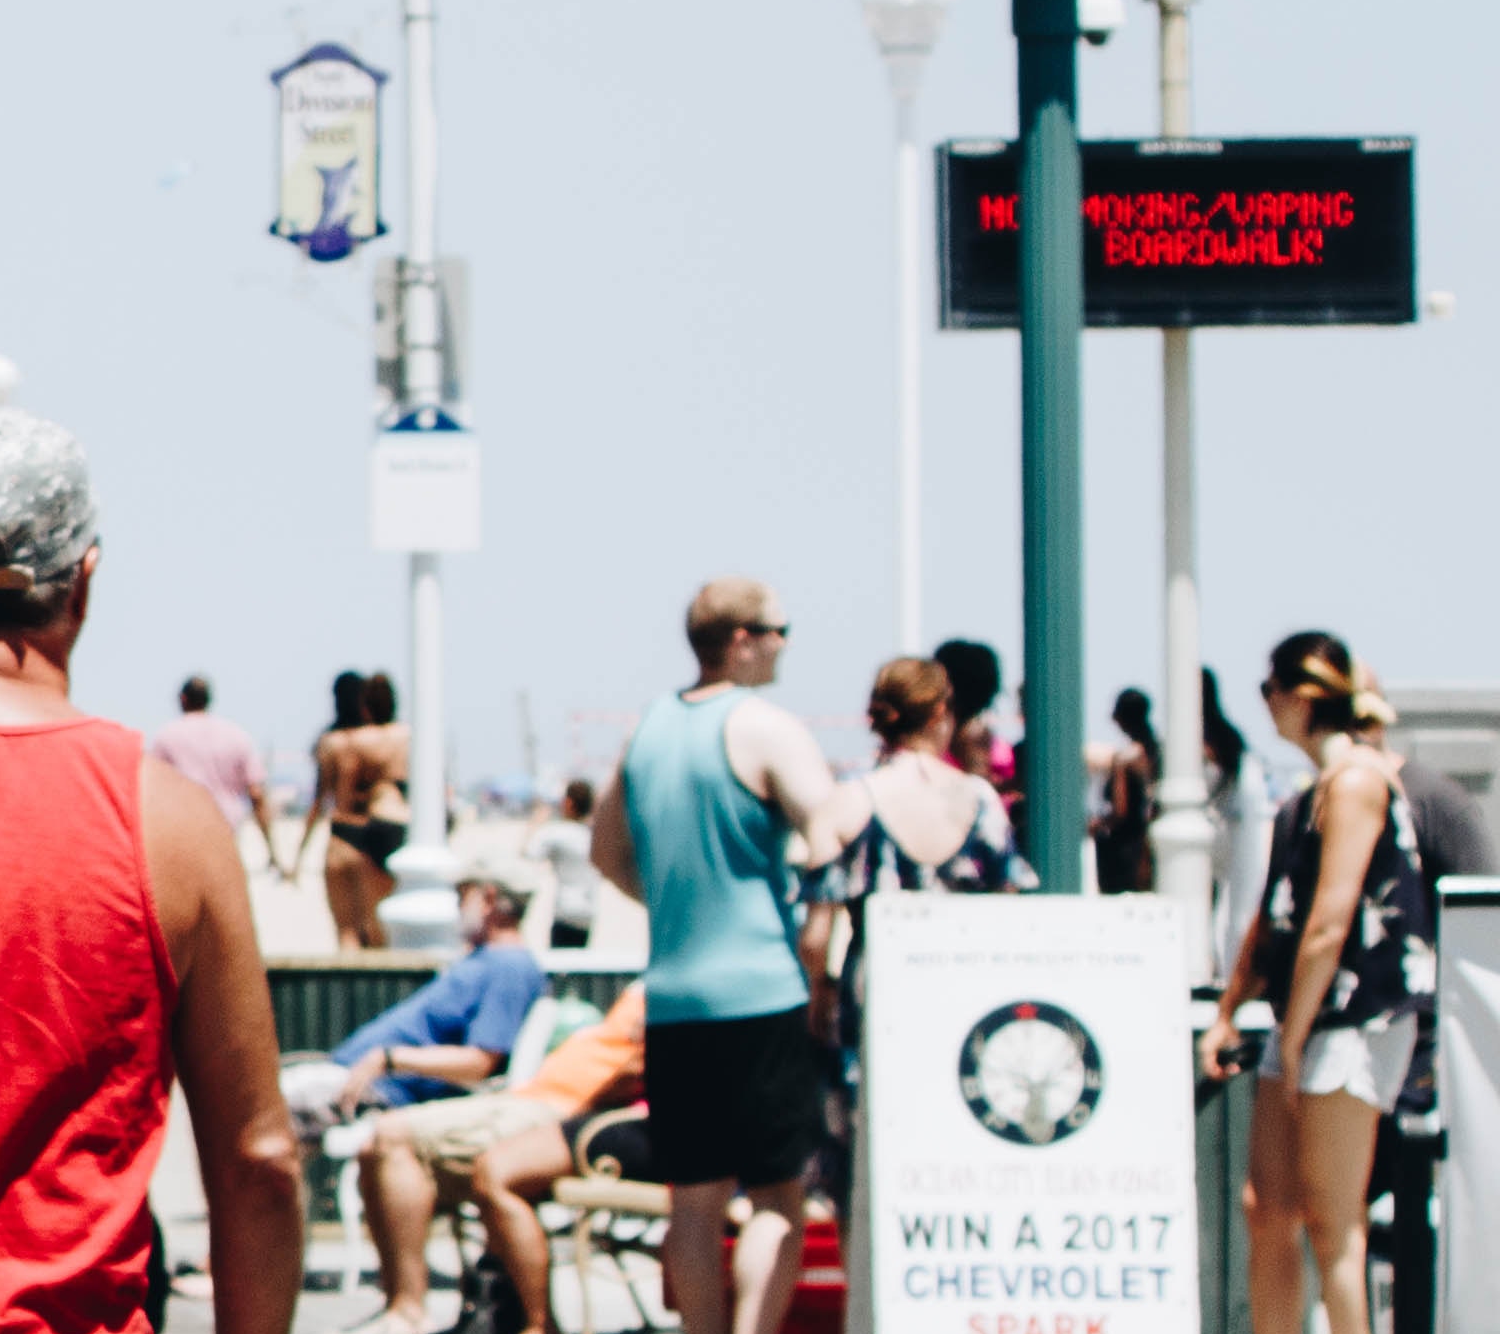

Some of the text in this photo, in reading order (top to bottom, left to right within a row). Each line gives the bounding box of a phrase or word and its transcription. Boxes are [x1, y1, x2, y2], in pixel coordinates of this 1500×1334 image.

[1081, 191, 1355, 229] MOKING/VAPING
[1105, 228, 1325, 267] BOARDWALK!
[898, 1214, 1171, 1250] WIN A 2017
[903, 1265, 1171, 1300] CHEVROLET
